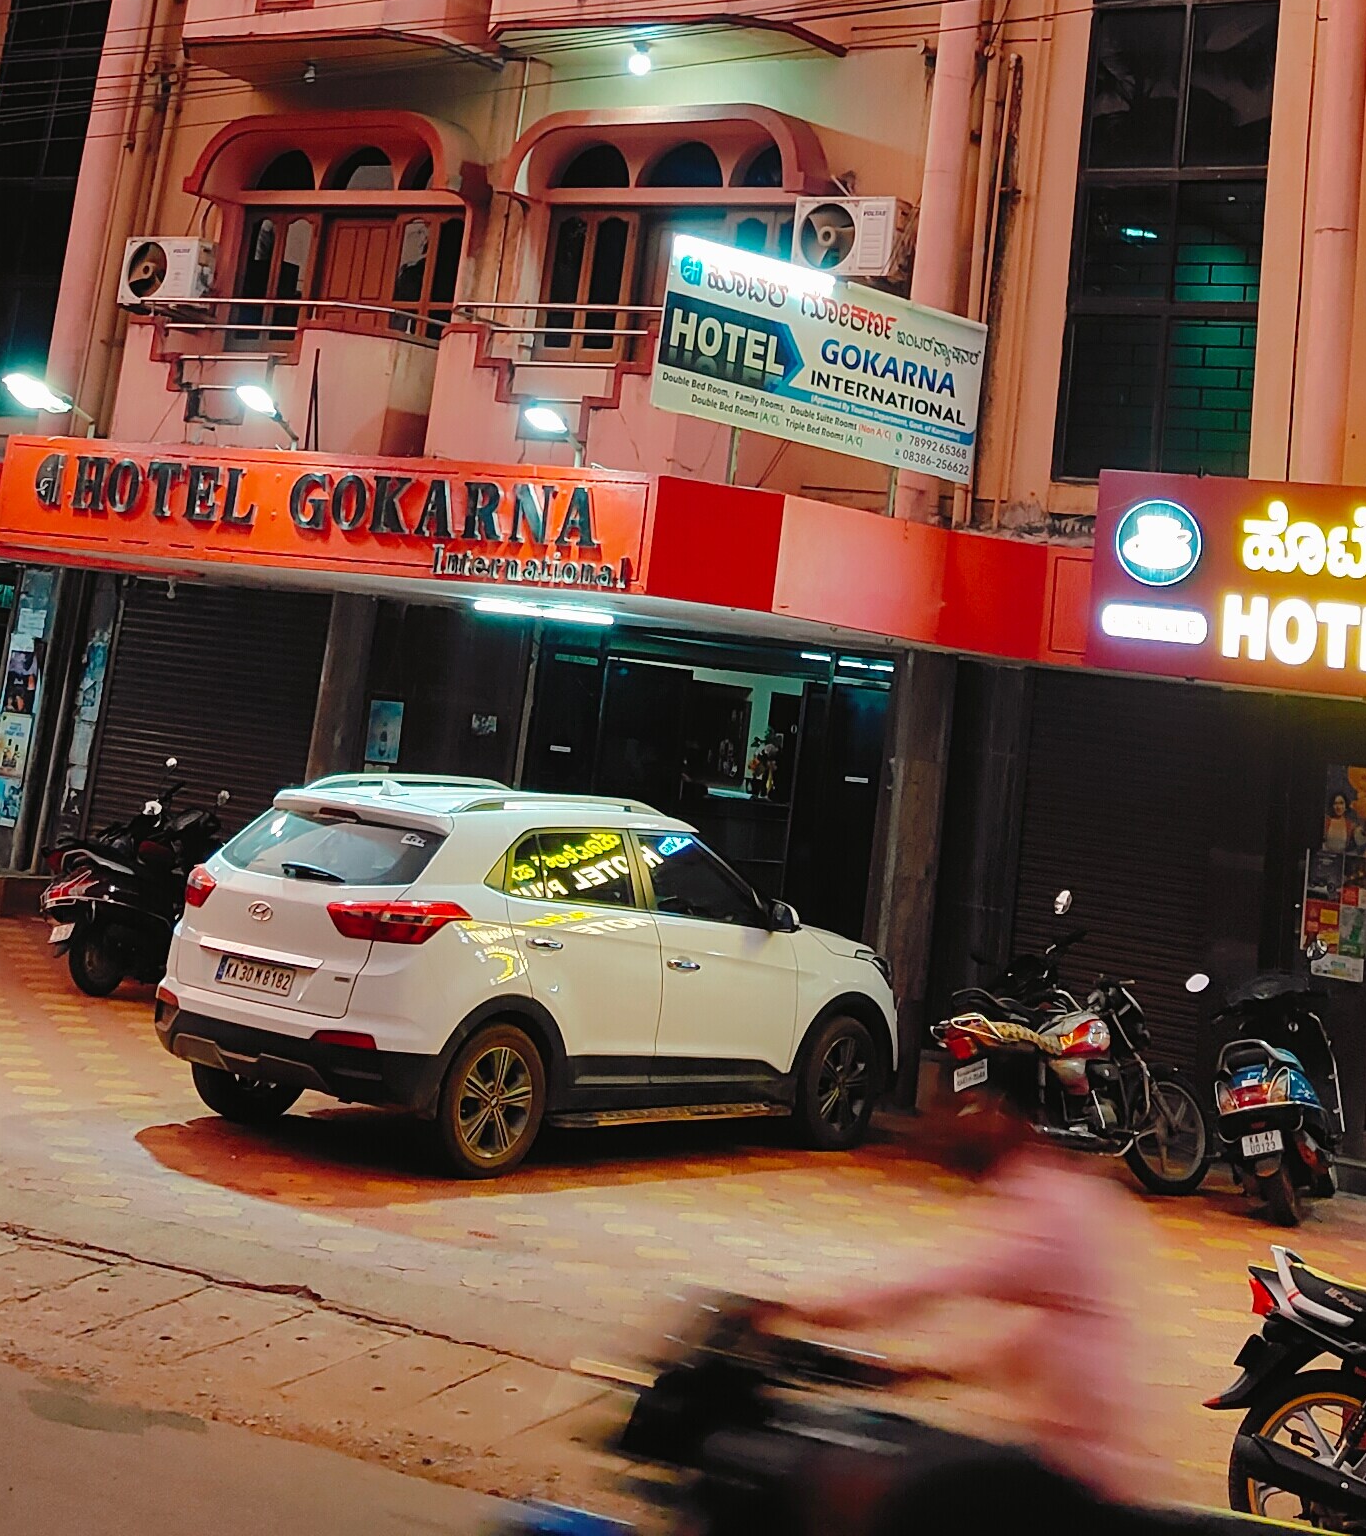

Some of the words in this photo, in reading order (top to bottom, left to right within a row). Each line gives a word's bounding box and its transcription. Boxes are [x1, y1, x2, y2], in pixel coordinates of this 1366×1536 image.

[669, 307, 785, 376] HOTEL
[821, 339, 956, 398] GOKARNA
[662, 371, 690, 387] Double
[691, 379, 706, 391] Bed
[707, 383, 730, 398] Room,
[735, 391, 759, 407] Family
[760, 397, 785, 412] Rooms,
[790, 405, 815, 420] Double
[816, 411, 833, 424] Suite
[835, 416, 857, 430] Rooms
[692, 394, 718, 409] Double
[719, 401, 734, 413] Bed
[735, 406, 759, 420] Rooms
[785, 418, 806, 432] Triple
[807, 424, 820, 435] Bed
[821, 427, 844, 441] Rooms
[811, 370, 966, 426] INTERNATIONAL
[903, 449, 969, 476] 08386-256622
[71, 456, 258, 527] HOTEL
[289, 472, 601, 548] GOKARNA
[432, 543, 633, 589] International
